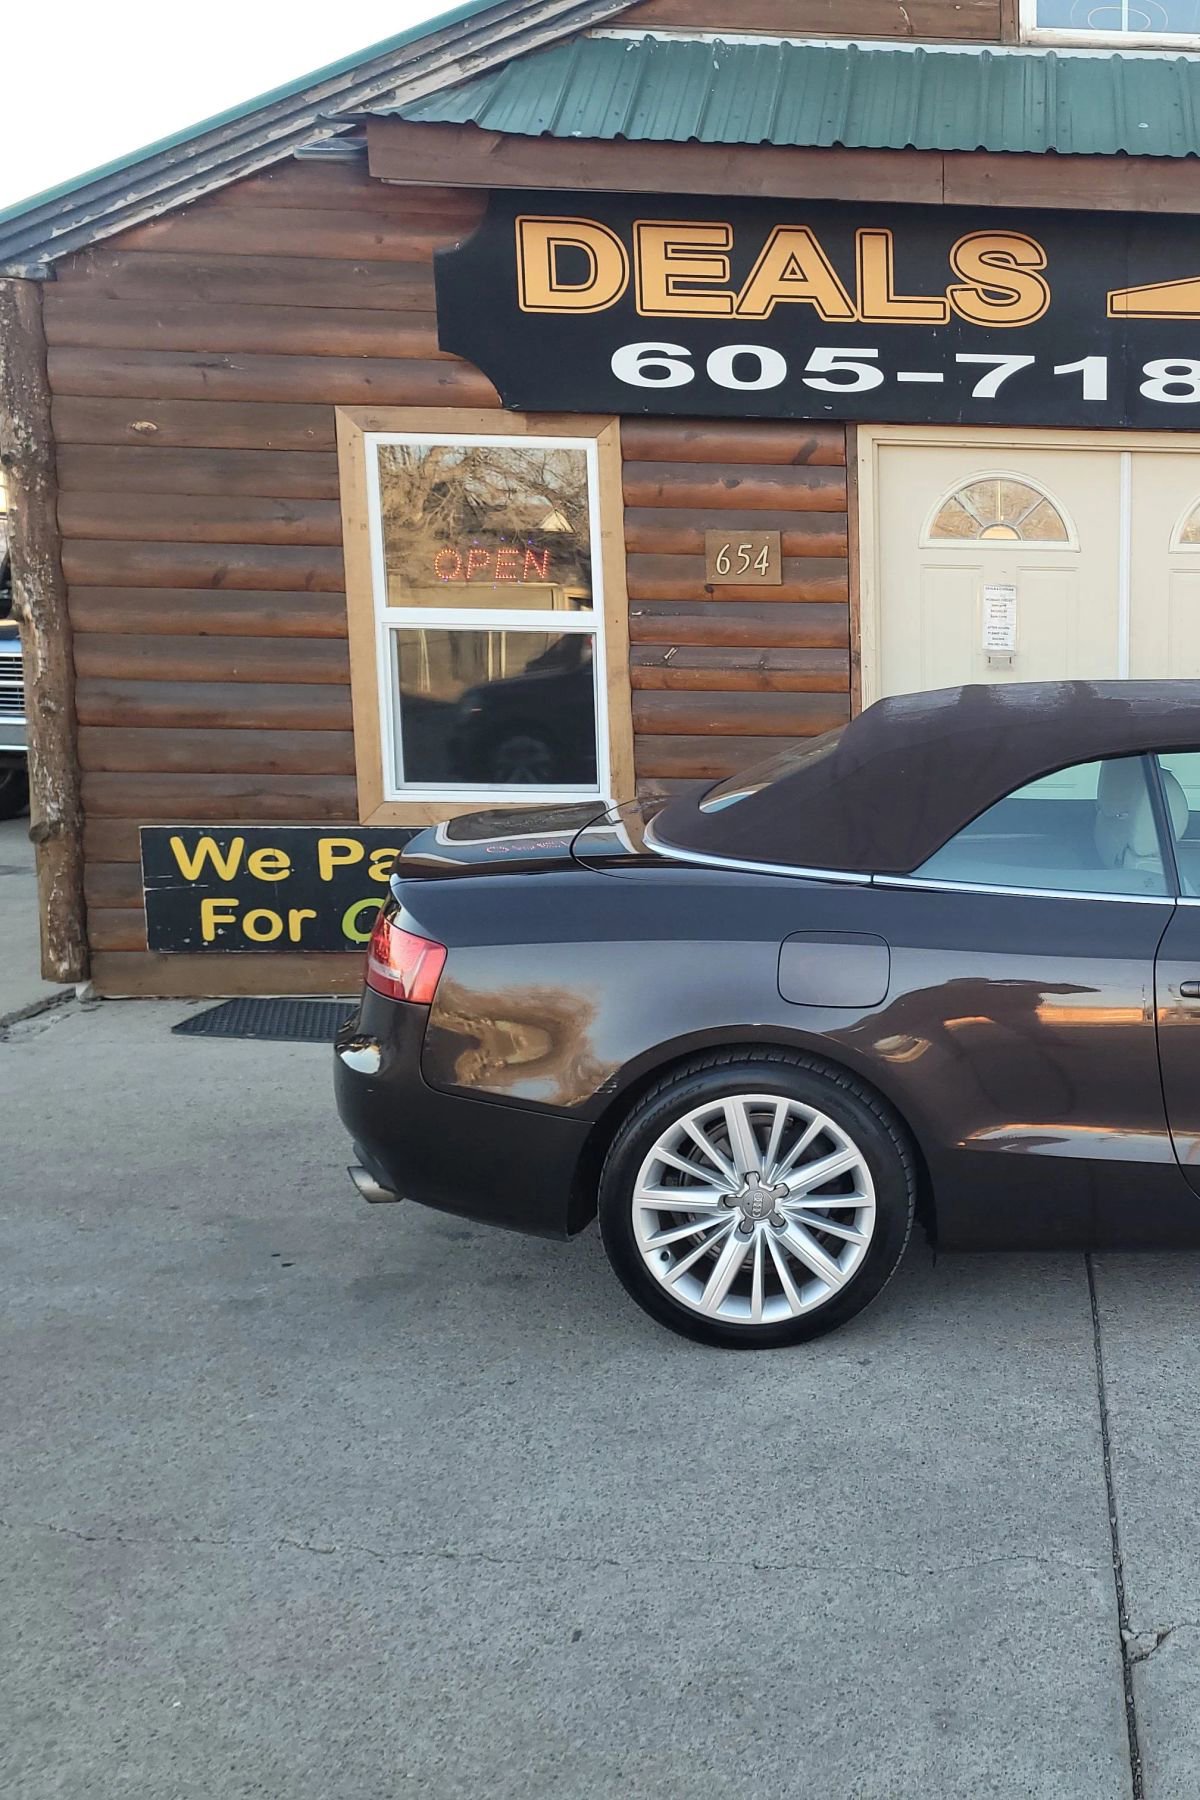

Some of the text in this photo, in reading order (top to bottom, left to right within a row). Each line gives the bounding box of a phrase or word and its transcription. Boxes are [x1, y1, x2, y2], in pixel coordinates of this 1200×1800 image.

[515, 215, 1051, 327] DEALS
[434, 548, 549, 579] OPEN
[716, 543, 769, 576] 654
[170, 836, 291, 881] We
[201, 898, 317, 942] For
